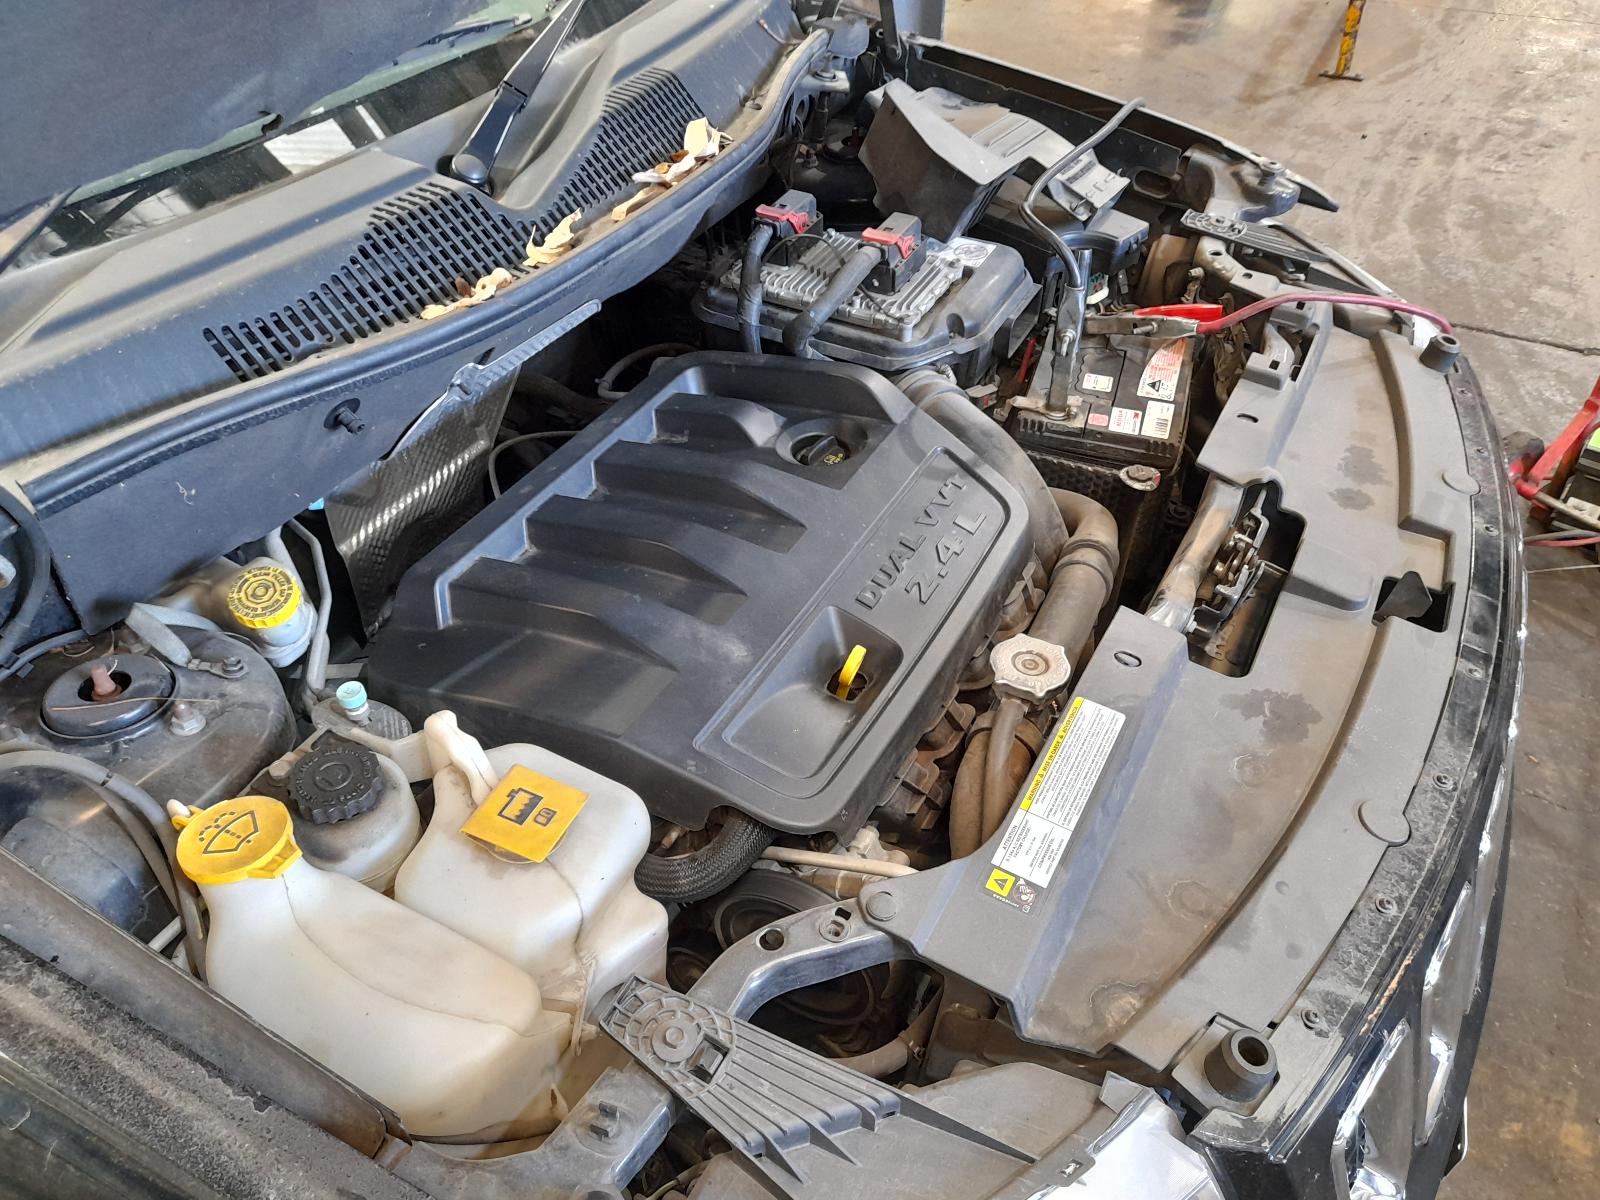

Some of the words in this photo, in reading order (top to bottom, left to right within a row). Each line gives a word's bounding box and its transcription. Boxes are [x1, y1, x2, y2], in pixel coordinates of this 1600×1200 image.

[855, 535, 927, 609] DUAL
[914, 473, 967, 527] VVT
[904, 512, 987, 605] 2.4L
[1027, 779, 1041, 801] WARNING
[1003, 825, 1018, 850] ATTENTION
